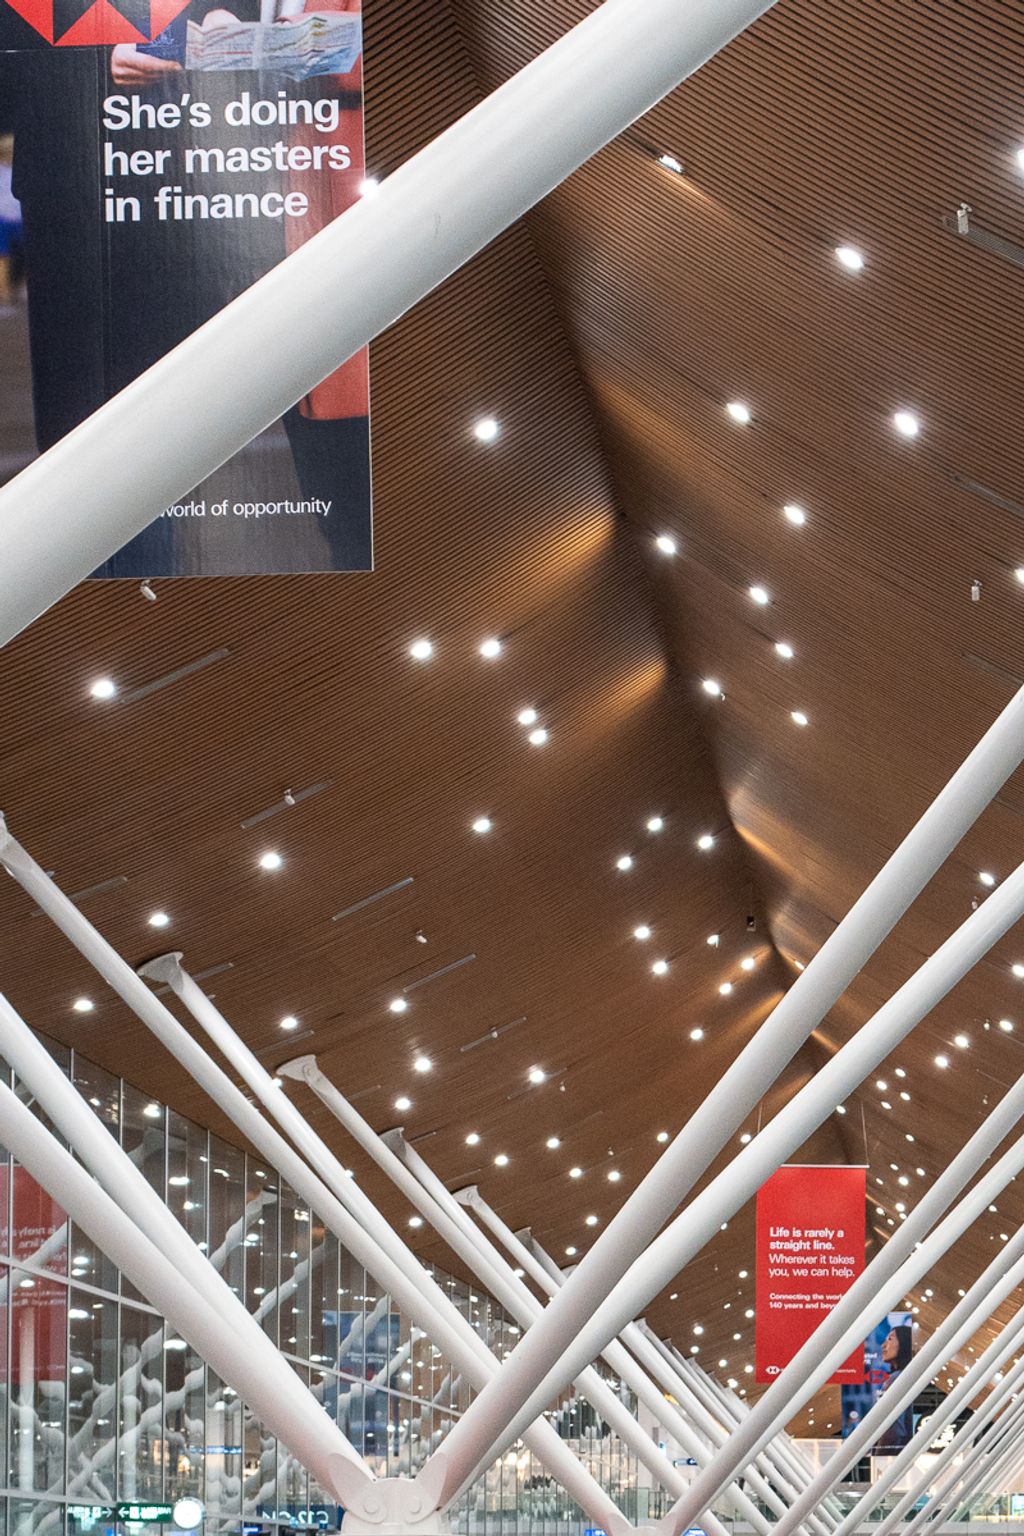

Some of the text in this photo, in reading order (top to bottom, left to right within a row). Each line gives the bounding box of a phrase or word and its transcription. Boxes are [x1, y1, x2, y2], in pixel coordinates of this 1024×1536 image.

[103, 91, 340, 133] She's doing
[104, 140, 351, 176] her masters
[105, 185, 309, 222] in finance
[211, 500, 229, 516] of
[232, 497, 332, 518] opportunity
[769, 1226, 844, 1240] Life is rarely a
[769, 1239, 835, 1252] straight line.
[768, 1253, 855, 1264] Wherever it takes
[768, 1266, 855, 1279] you, we can help.
